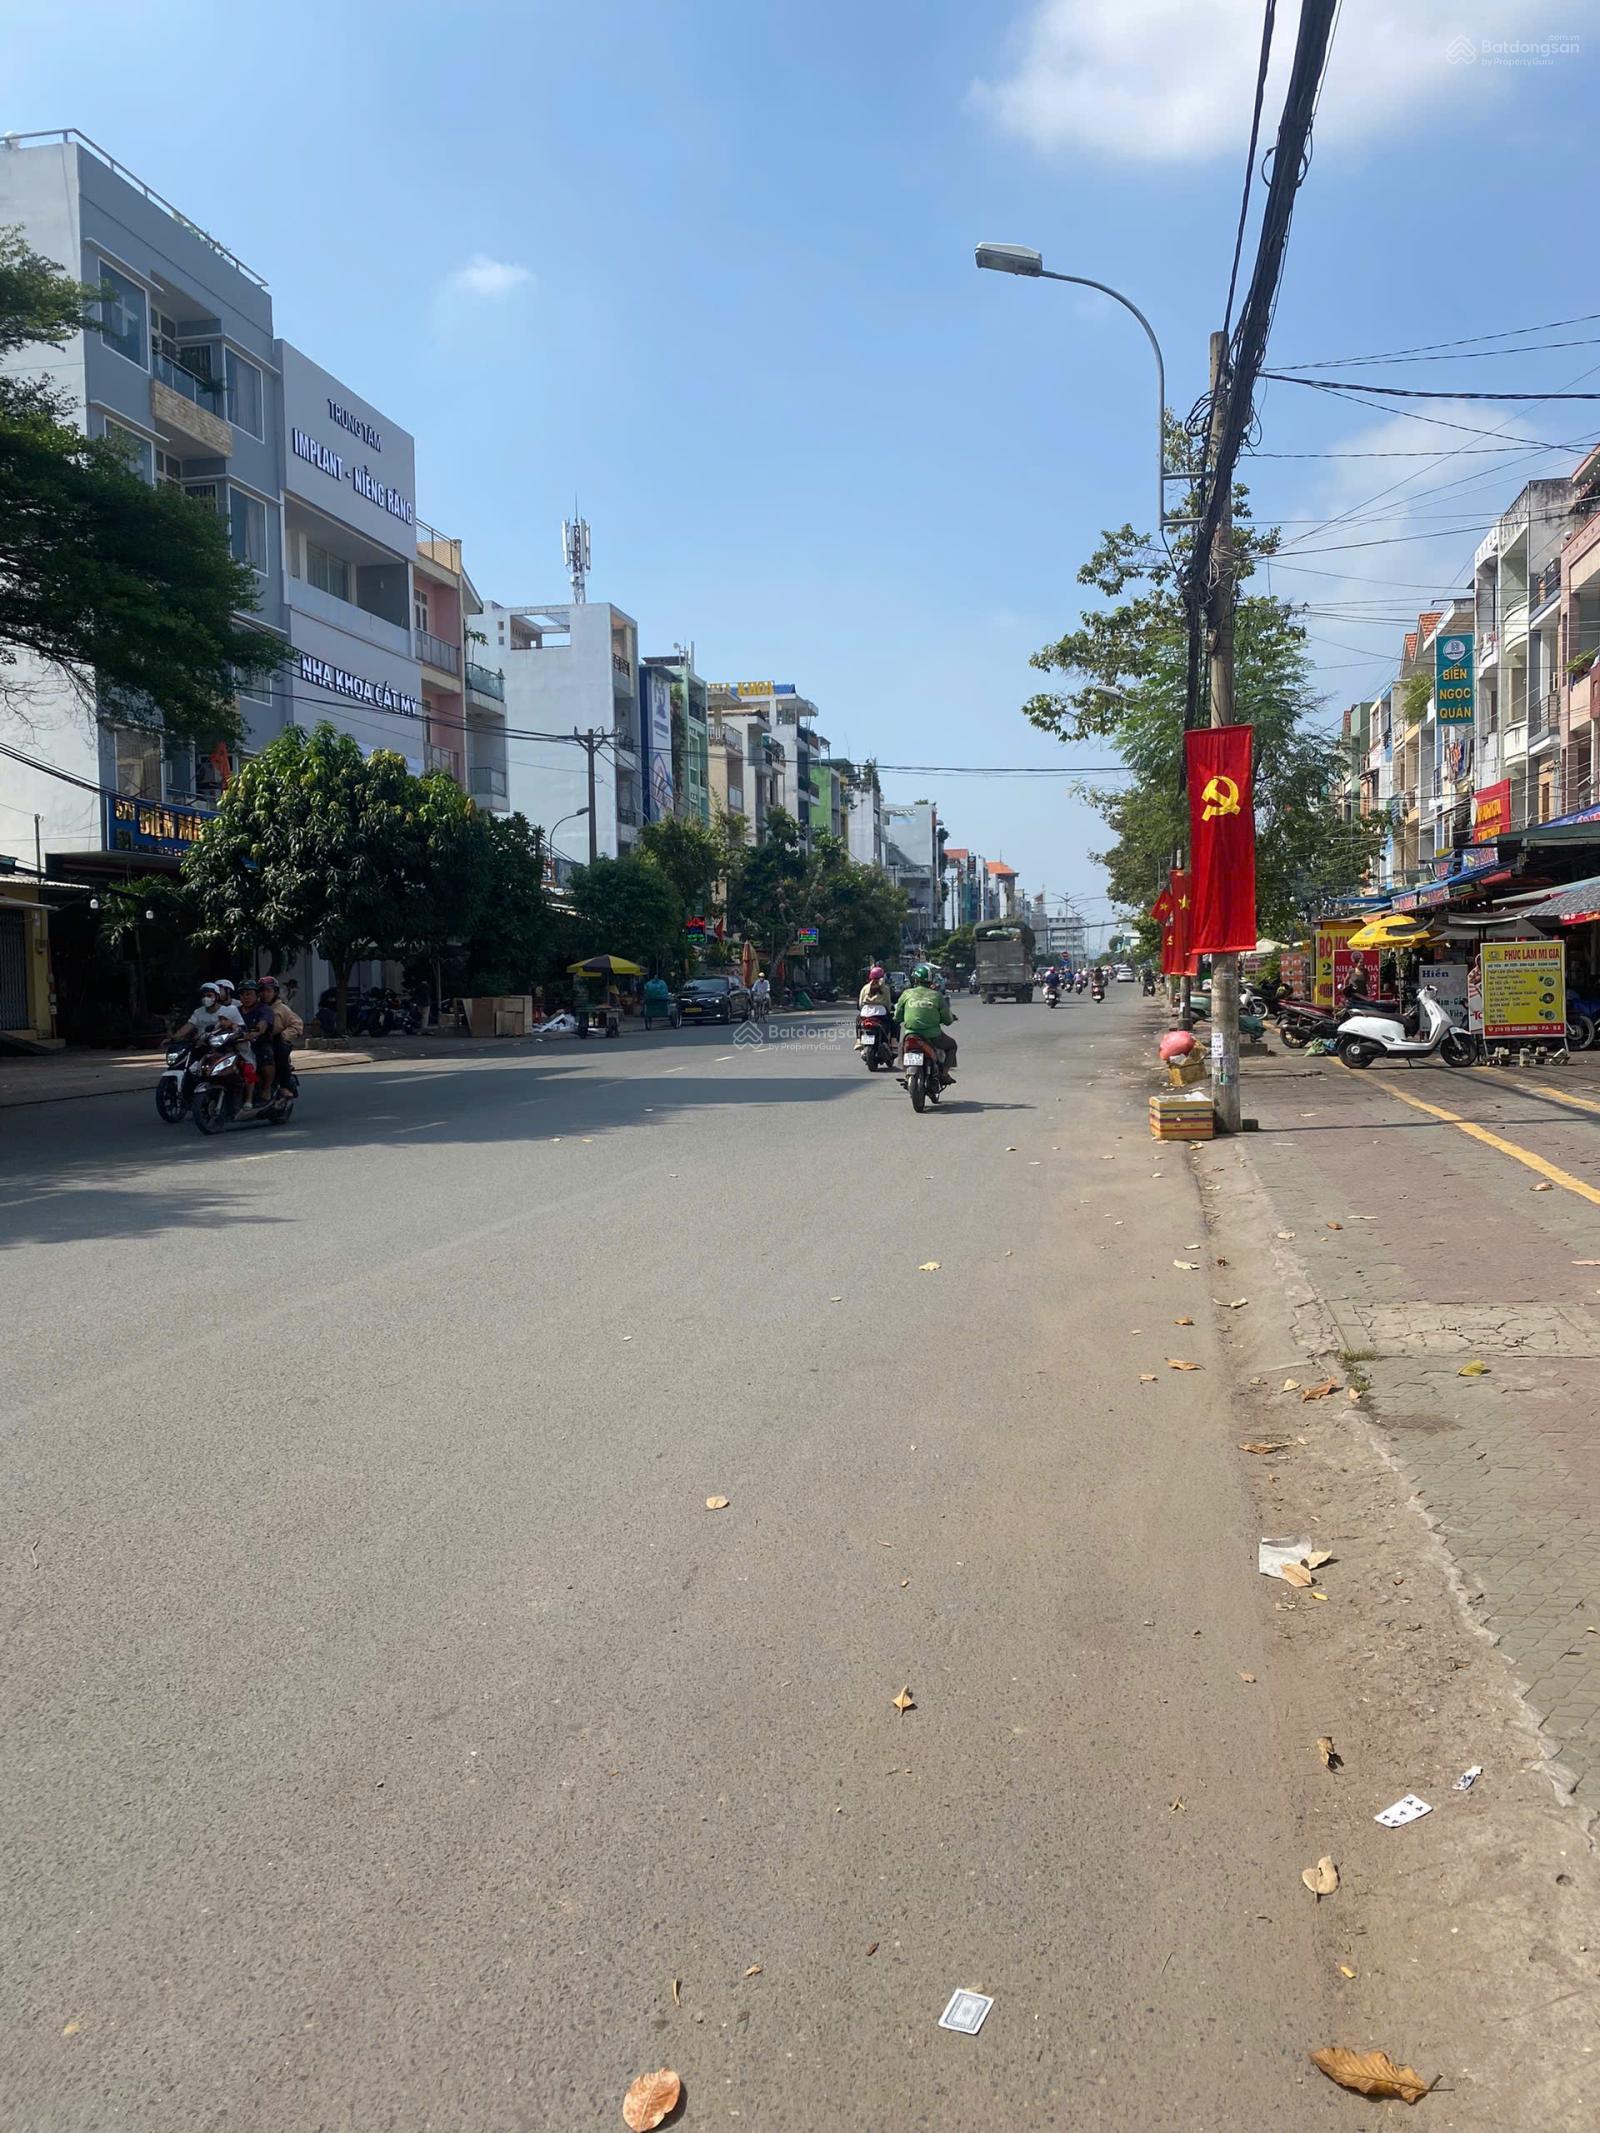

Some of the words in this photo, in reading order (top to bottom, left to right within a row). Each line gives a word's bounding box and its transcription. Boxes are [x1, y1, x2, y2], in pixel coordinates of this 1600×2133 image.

[327, 398, 361, 438] TRUNG
[292, 427, 342, 481] IMPLANT
[301, 654, 332, 689] NHA
[334, 668, 373, 703] KHOA
[1440, 687, 1471, 702] NGỌC
[1440, 703, 1472, 719] QUÁN
